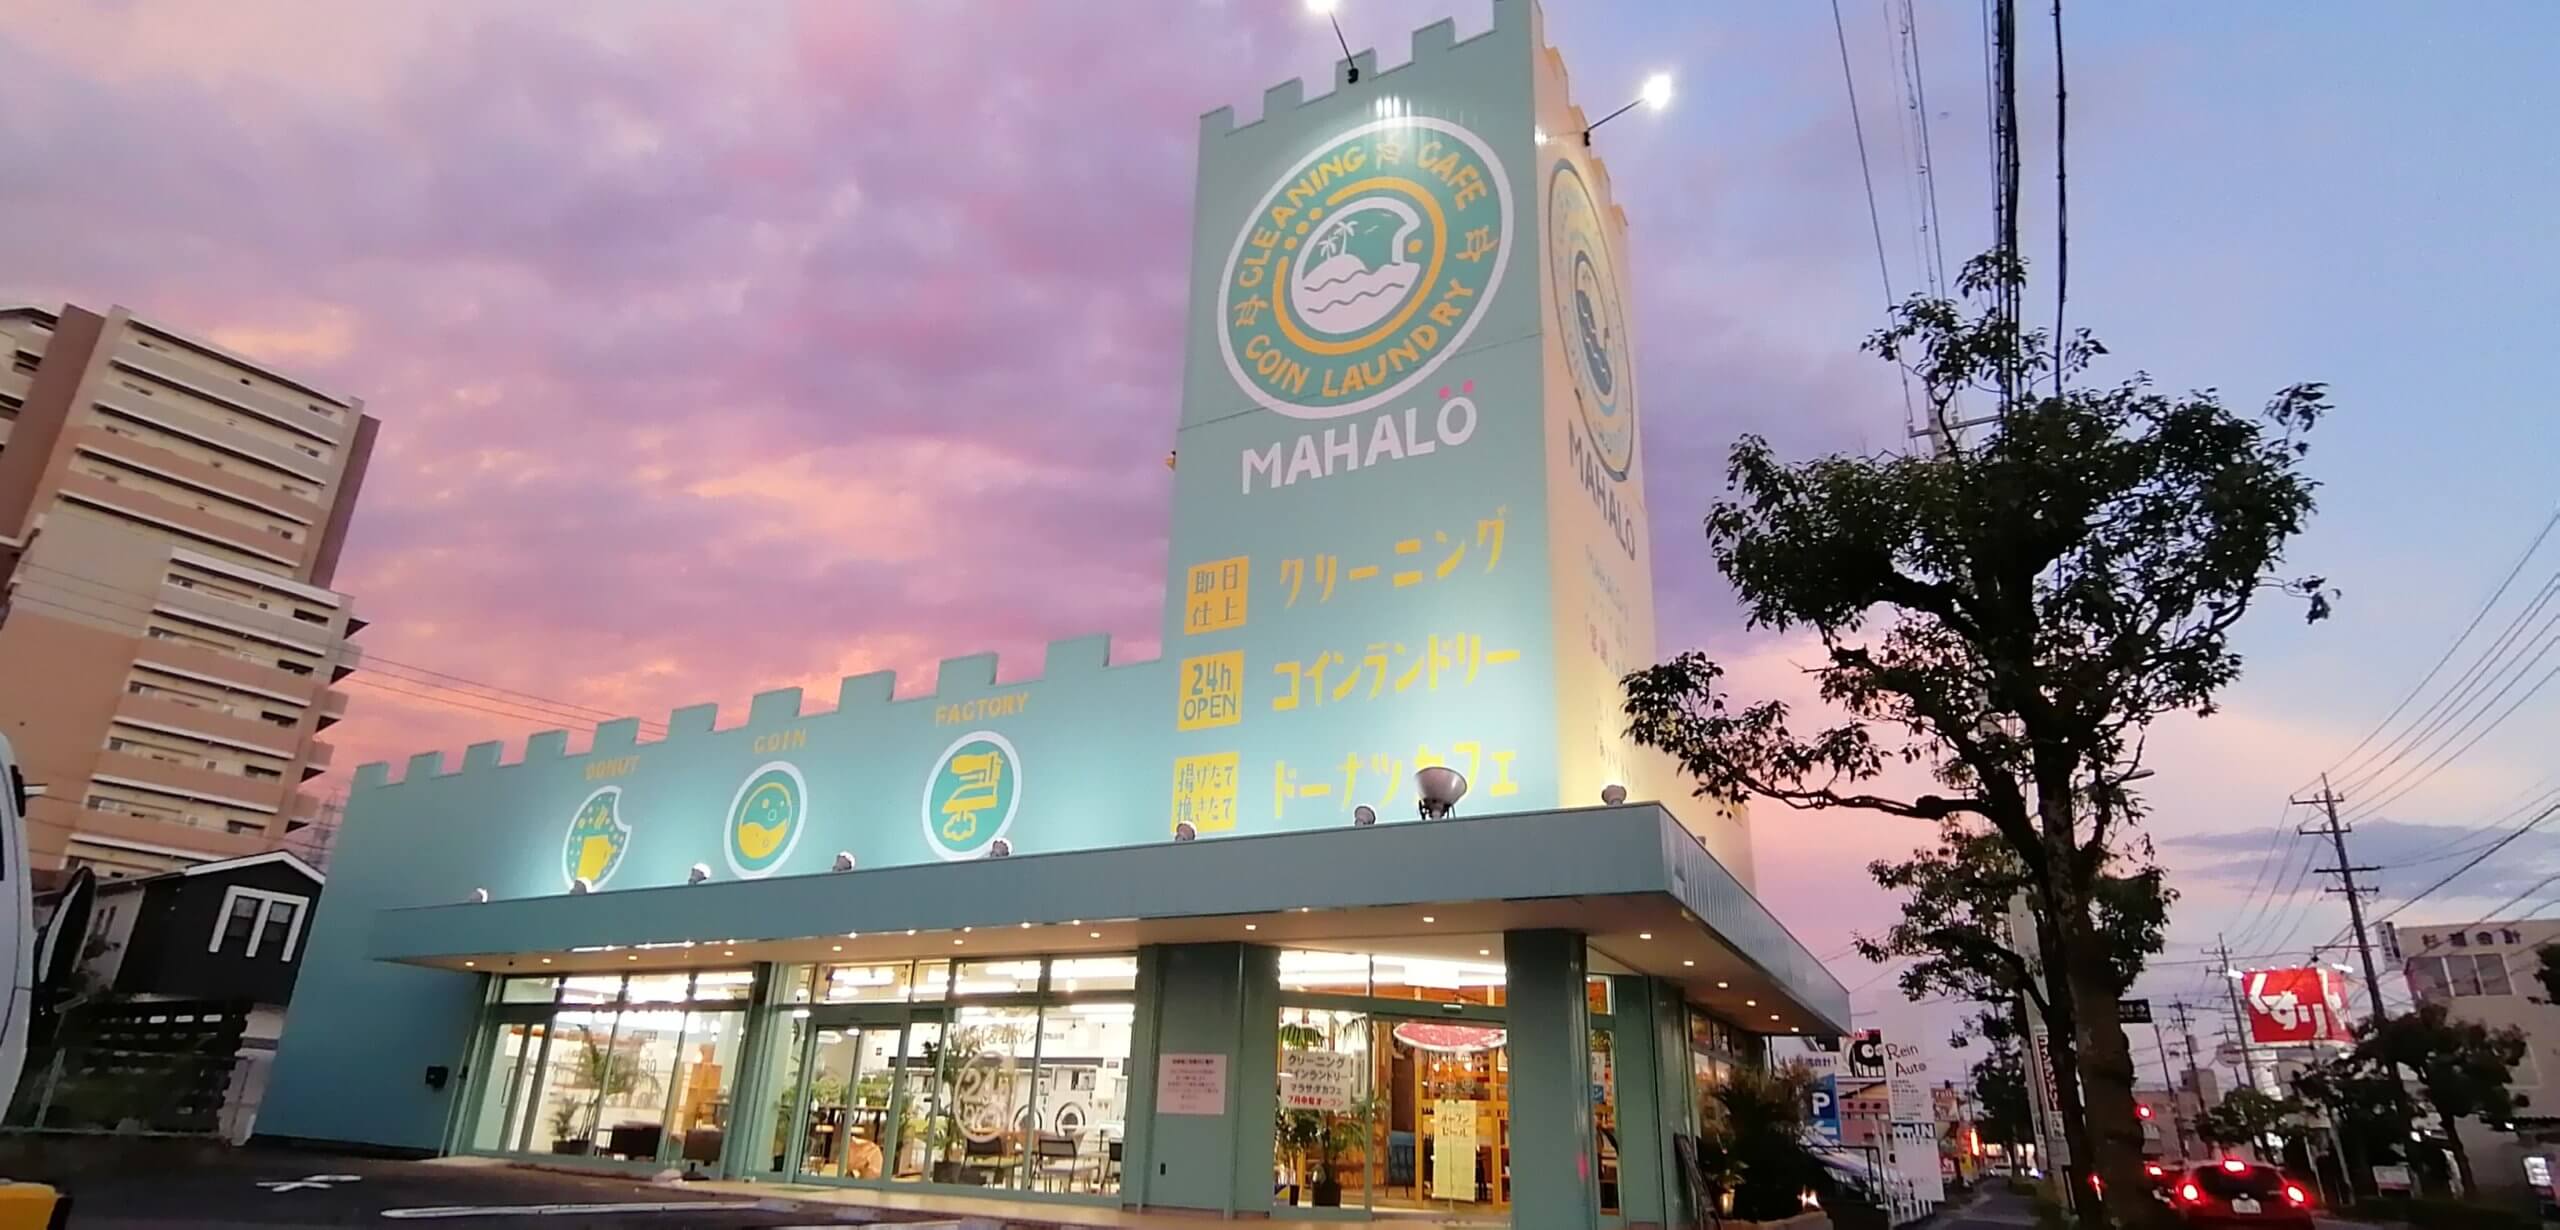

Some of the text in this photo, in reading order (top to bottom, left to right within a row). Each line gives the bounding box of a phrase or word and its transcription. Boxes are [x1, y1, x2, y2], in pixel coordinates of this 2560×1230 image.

[1417, 140, 1488, 210] CAFE
[1238, 145, 1367, 287] CLEANING
[1245, 278, 1475, 398] COIN LAUNDRY
[1280, 504, 1508, 609] クリーニング
[1193, 563, 1239, 594] 即日
[1192, 596, 1239, 627] 仕上
[1191, 660, 1232, 696] 24h
[1272, 632, 1521, 712] コインランドリー
[935, 692, 1029, 727] FACTORY
[1183, 693, 1237, 722] OPEN
[753, 728, 807, 755] COIN
[585, 754, 640, 781] DONUT
[1288, 1053, 1346, 1069] クリーニング
[1885, 1043, 1919, 1060] Rein
[1895, 1061, 1927, 1077] Auto
[1812, 1092, 1831, 1116] P
[1914, 1123, 1935, 1139] IN
